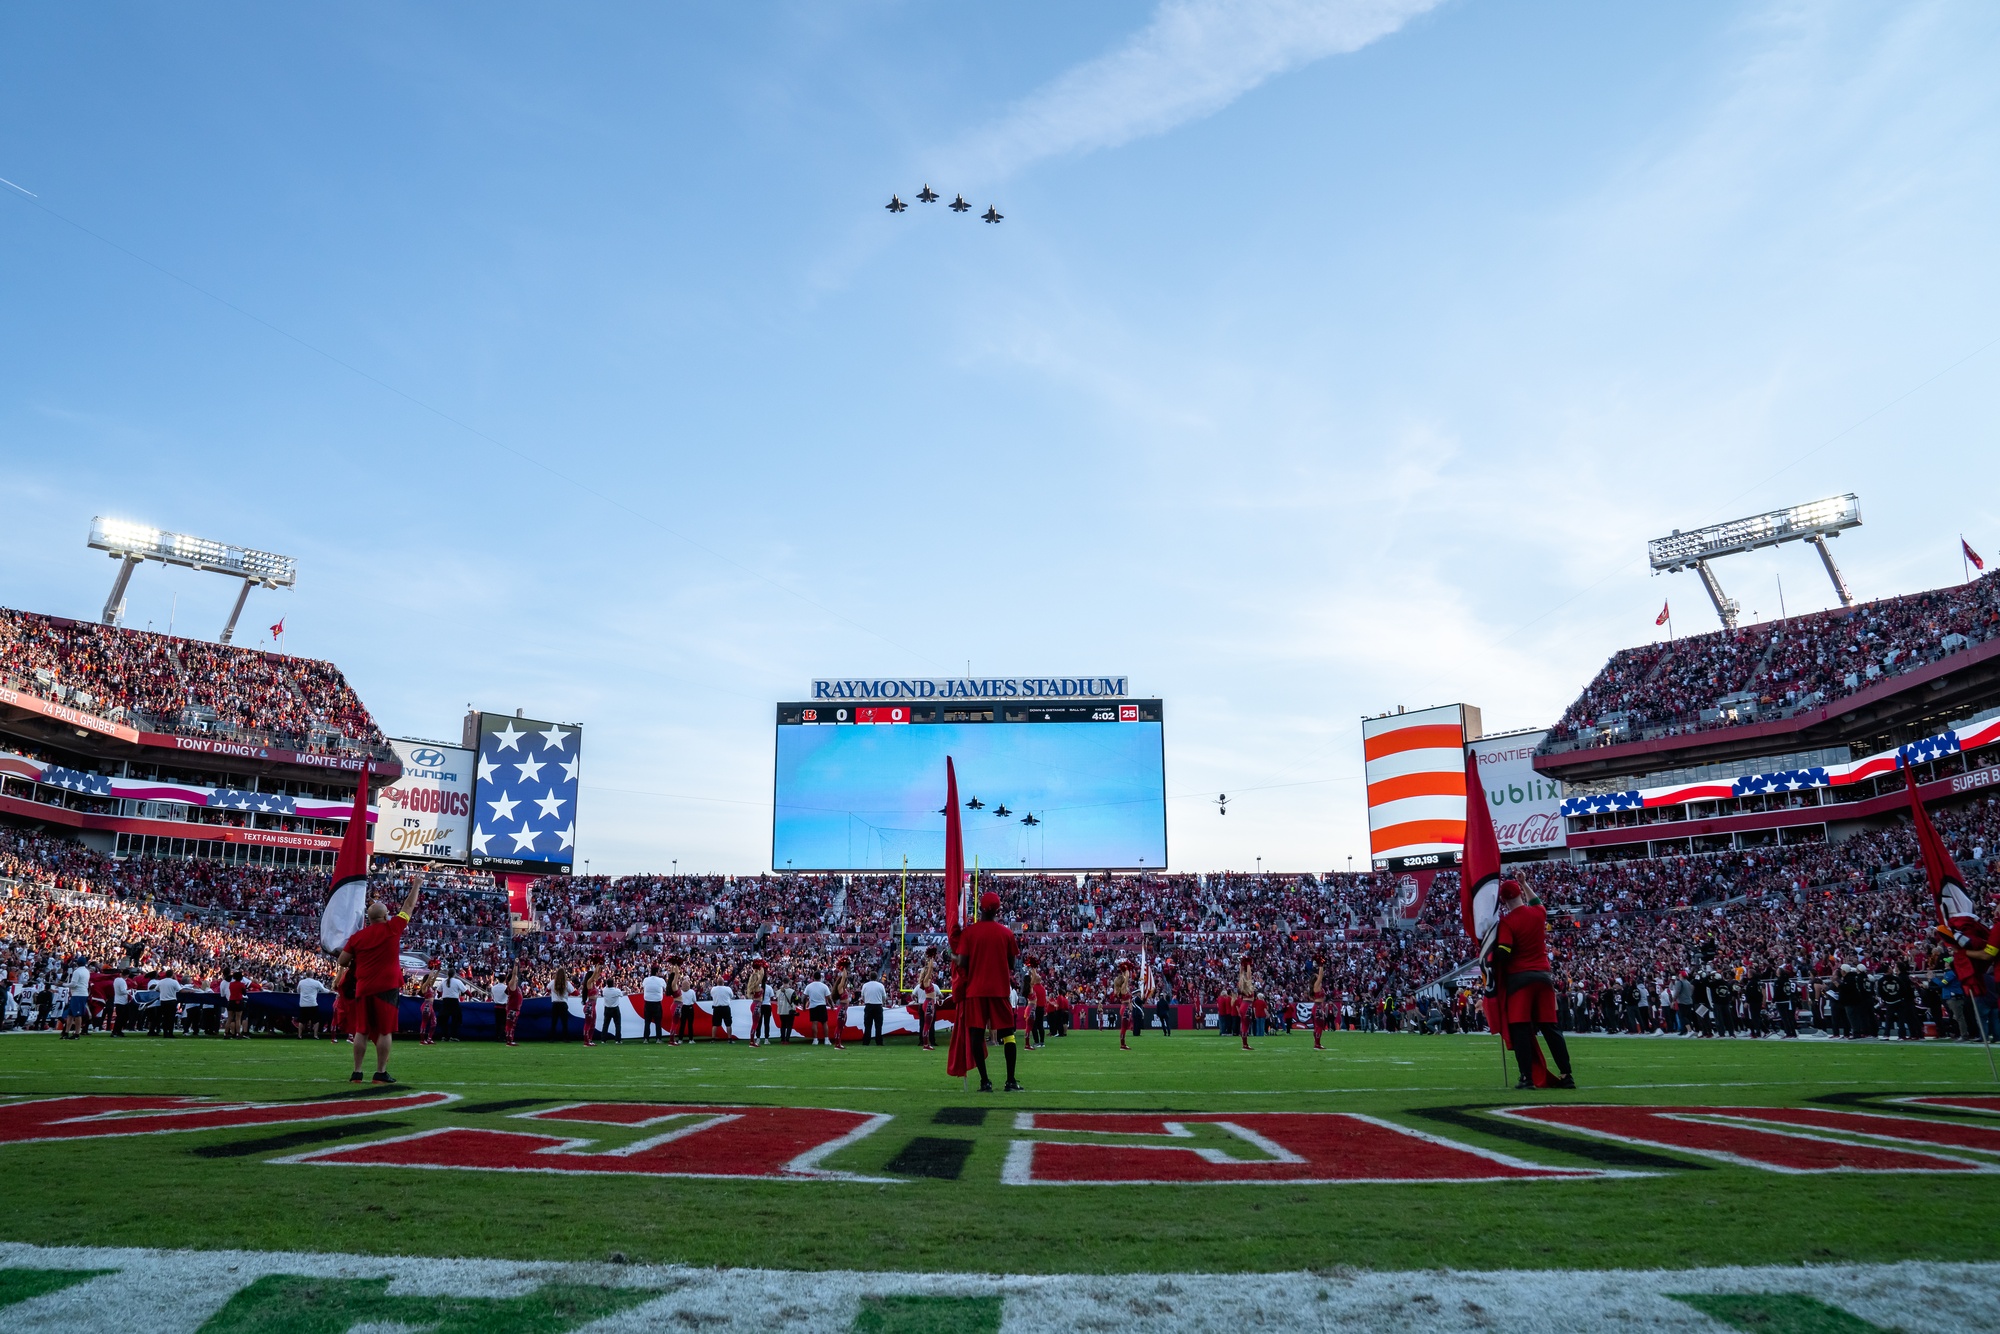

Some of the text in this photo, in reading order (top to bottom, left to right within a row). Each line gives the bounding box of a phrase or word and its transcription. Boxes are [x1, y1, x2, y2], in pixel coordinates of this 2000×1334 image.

[814, 678, 1125, 698] RAYMOND JAMES STADIUM
[42, 701, 116, 735] 74 PAUL GRUBER
[836, 709, 847, 721] 0
[891, 708, 903, 721] 0
[1091, 712, 1115, 720] 4:02
[1122, 710, 1136, 718] 25
[175, 737, 258, 757] TONY DUNGY
[296, 753, 376, 772] MONTE KIFFN
[1952, 771, 1990, 792] SUPER
[1483, 779, 1559, 806] ublix
[401, 787, 469, 817] #GOBUCS
[403, 818, 420, 828] IT'S
[1491, 812, 1562, 845] oca-Cola
[243, 833, 331, 848] TEXT FAN ISSUES TO 33607
[390, 828, 454, 851] Miller
[422, 844, 452, 857] TIME
[1403, 855, 1439, 867] $20,193
[22, 991, 32, 999] 30
